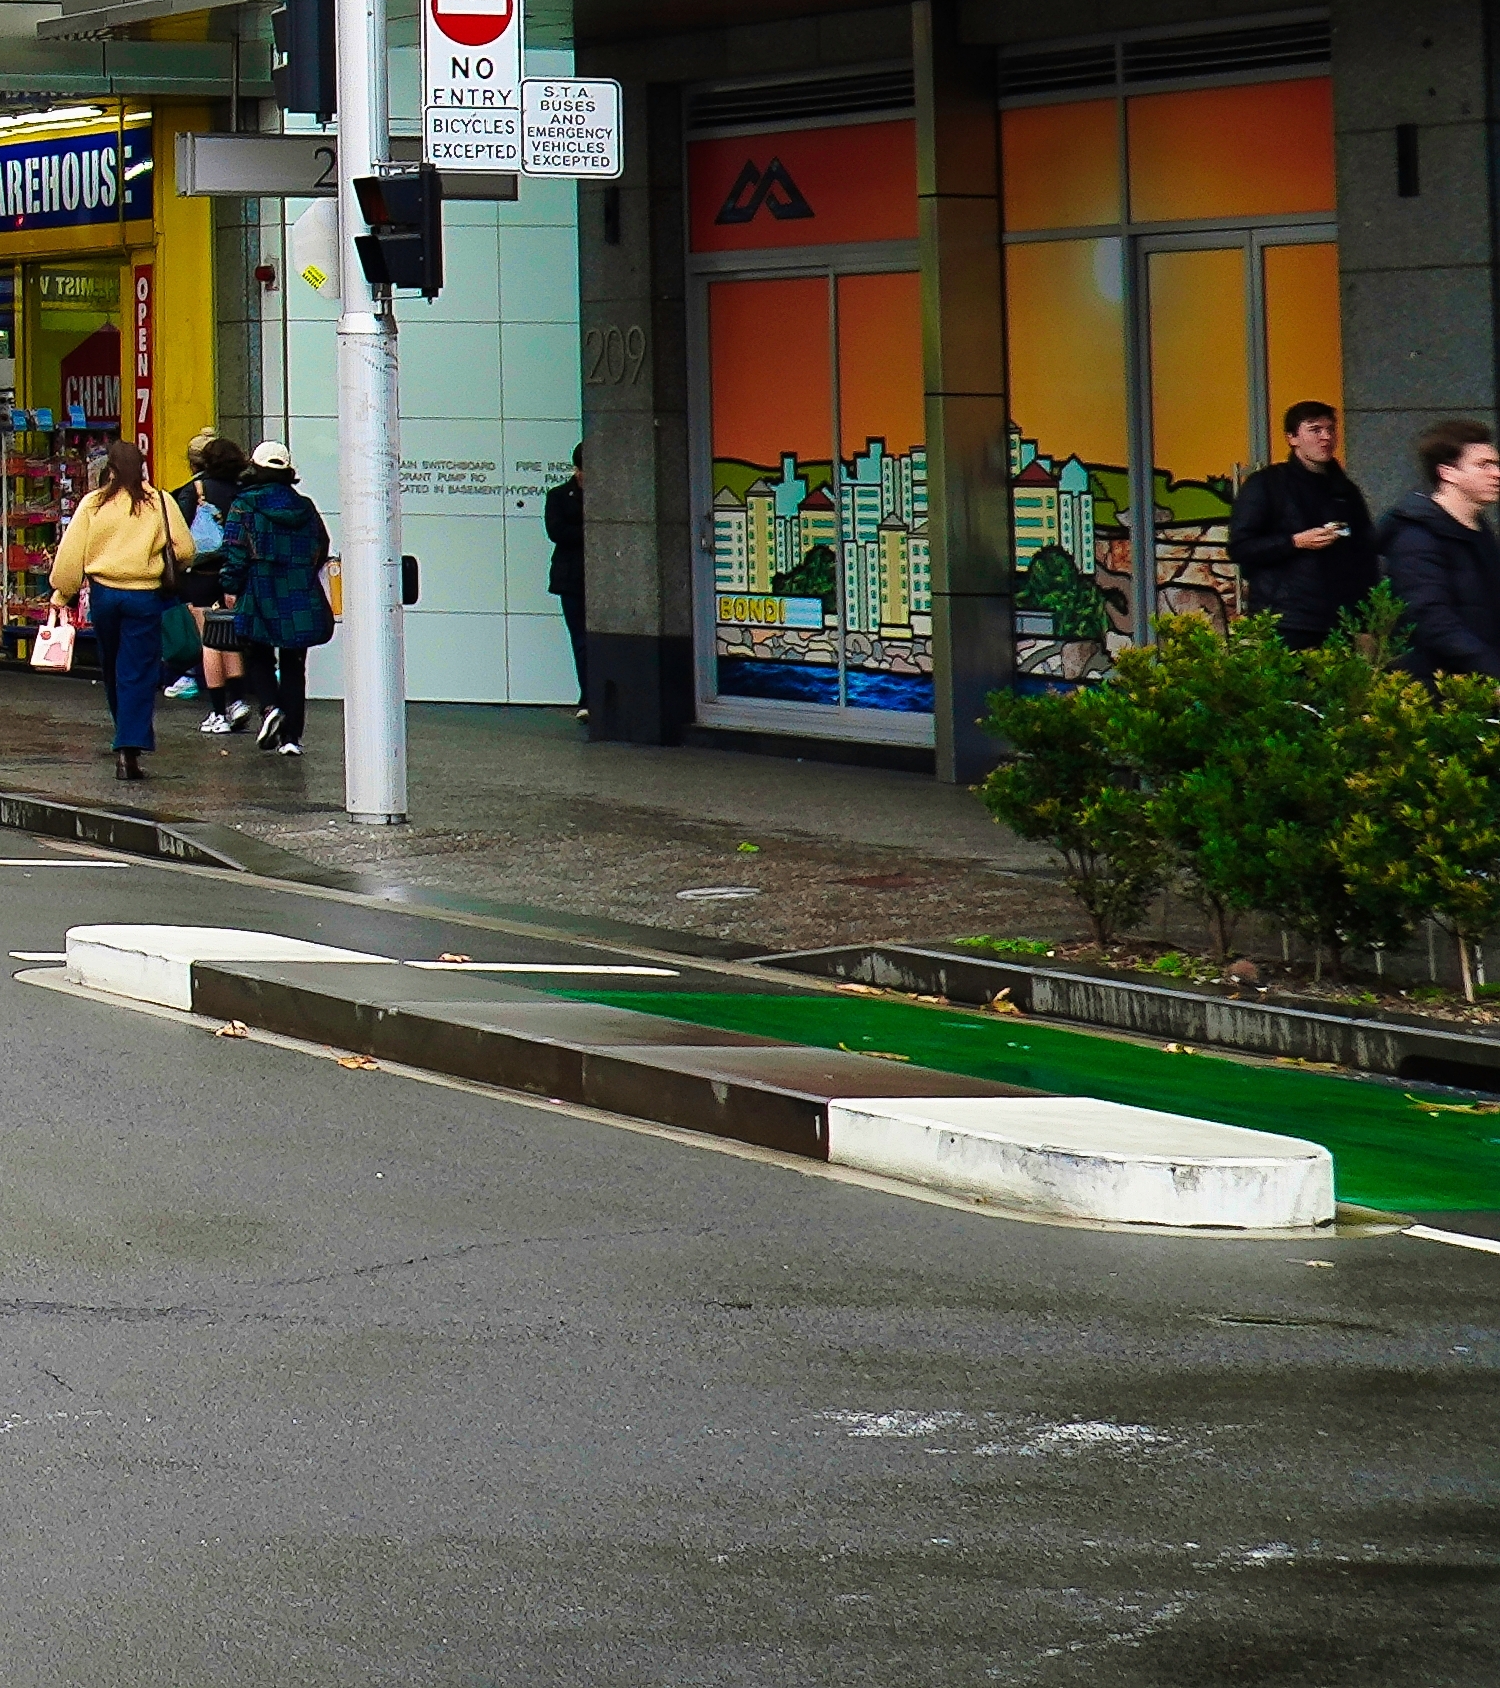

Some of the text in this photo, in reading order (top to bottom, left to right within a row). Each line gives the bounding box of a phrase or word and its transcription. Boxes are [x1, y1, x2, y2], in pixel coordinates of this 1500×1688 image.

[451, 56, 494, 80] NO
[433, 88, 513, 106] ENTRY
[543, 85, 594, 99] S.T.A.
[540, 100, 596, 112] BUSES
[433, 118, 515, 135] BICYCLES
[550, 114, 586, 126] AND
[527, 126, 613, 140] EMERGENCY
[432, 143, 517, 159] EXCEPTED
[531, 140, 605, 154] VEHICLES
[532, 155, 611, 168] EXCEPTED
[136, 276, 149, 378] OPEN
[584, 325, 648, 386] 209
[136, 387, 150, 424] 7
[422, 461, 496, 471] SWITCHBOARD
[437, 472, 467, 483] PUMP
[448, 484, 503, 495] BASEMENT
[719, 596, 786, 624] BONDI
